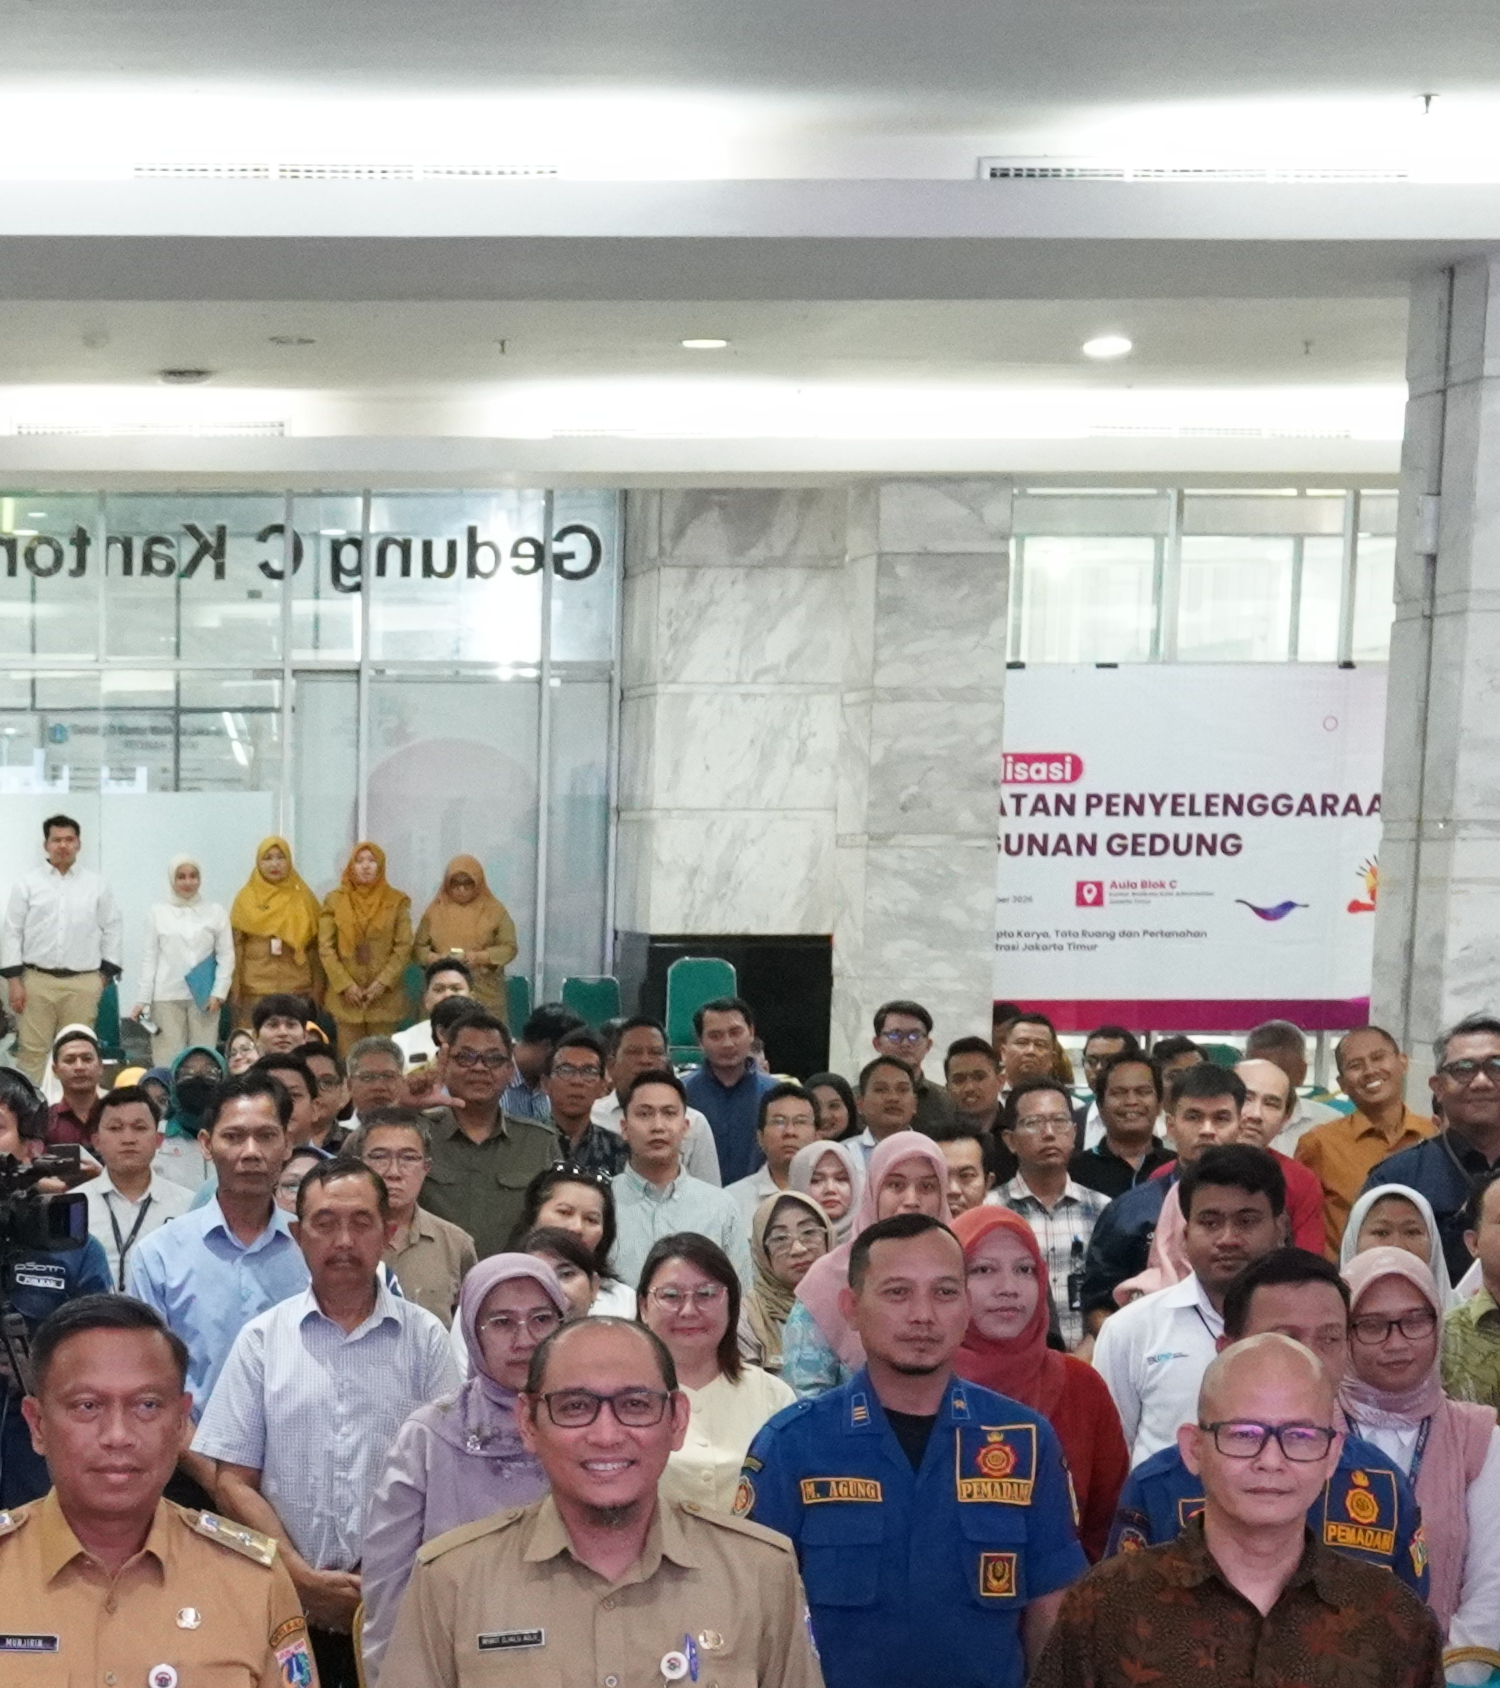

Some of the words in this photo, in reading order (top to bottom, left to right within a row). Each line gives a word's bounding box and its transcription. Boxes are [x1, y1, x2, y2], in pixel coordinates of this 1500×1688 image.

[998, 833, 1098, 857] UNAN
[1106, 832, 1243, 857] GEDUNG
[1109, 879, 1138, 890] Aula
[1140, 879, 1166, 890] Blok
[1169, 880, 1177, 889] C
[1054, 929, 1079, 939] Tata
[1081, 929, 1116, 941] Ruang
[1119, 929, 1140, 938] dan
[1142, 929, 1208, 939] Pertanahan
[1021, 942, 1064, 952] Jakarta
[1066, 942, 1099, 952] Timur
[829, 1481, 877, 1498] AGUNG
[960, 1482, 1030, 1501] PEMADAM
[1327, 1524, 1392, 1552] PEMADAM
